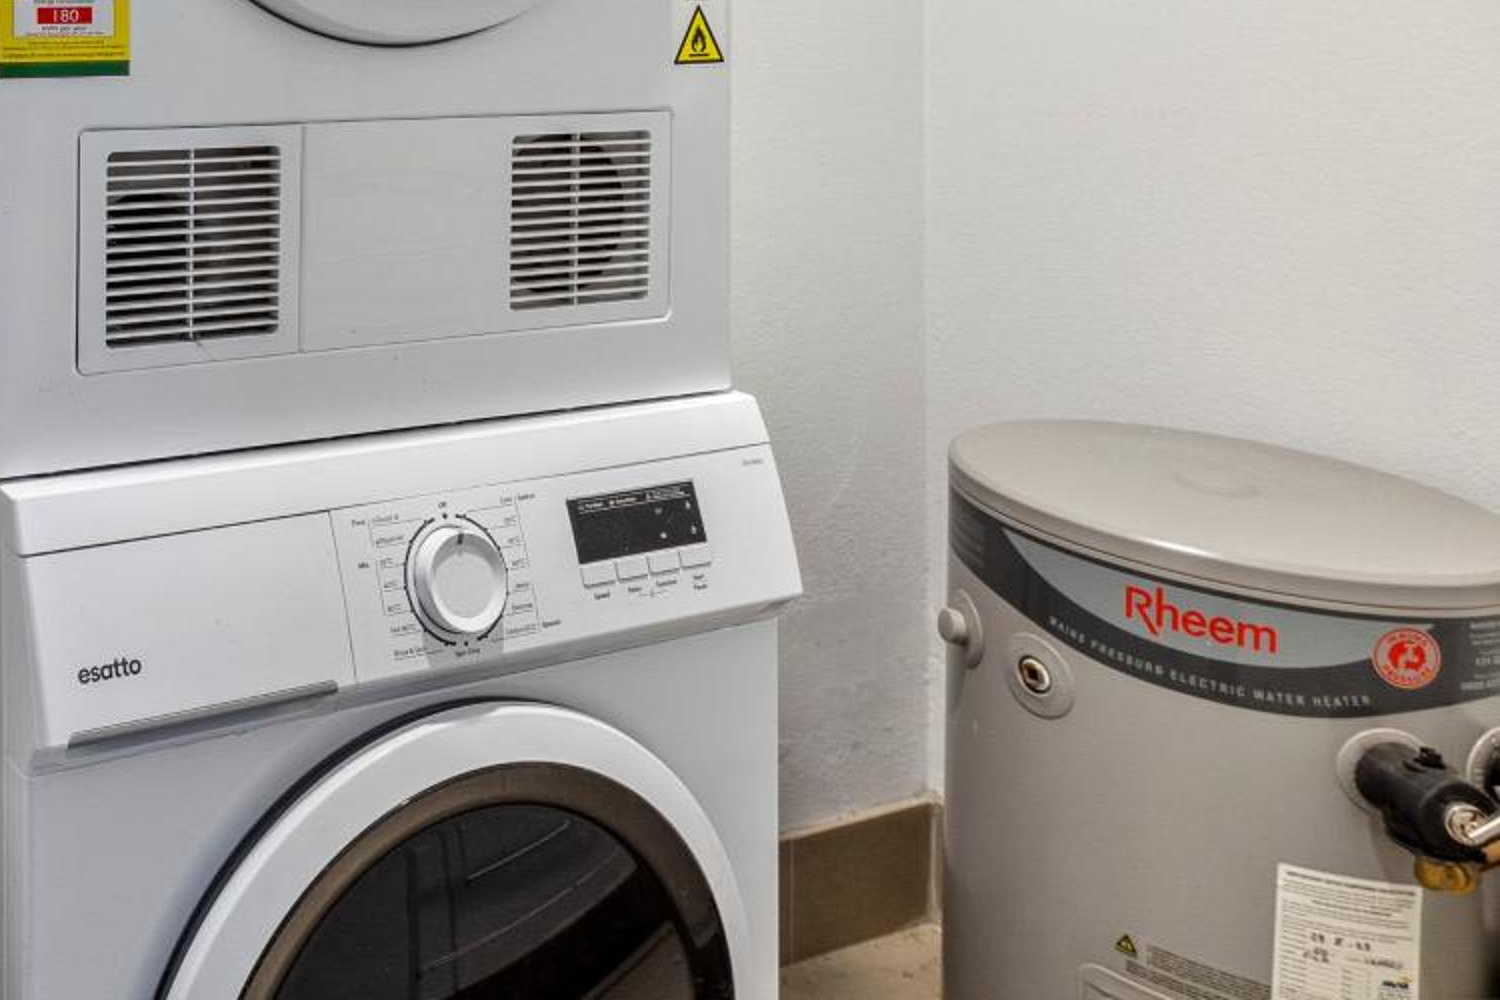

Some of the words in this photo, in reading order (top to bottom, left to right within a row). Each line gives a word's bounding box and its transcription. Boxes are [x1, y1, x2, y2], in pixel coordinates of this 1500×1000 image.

[53, 8, 80, 23] 180
[1124, 584, 1279, 654] Rheem
[77, 656, 143, 685] esatto
[1049, 615, 1086, 644] MAINS
[1090, 639, 1164, 676] PRESSURE
[1169, 668, 1247, 698] ELECTRIC
[1252, 687, 1306, 706] WATER
[1312, 694, 1371, 709] HEATER
